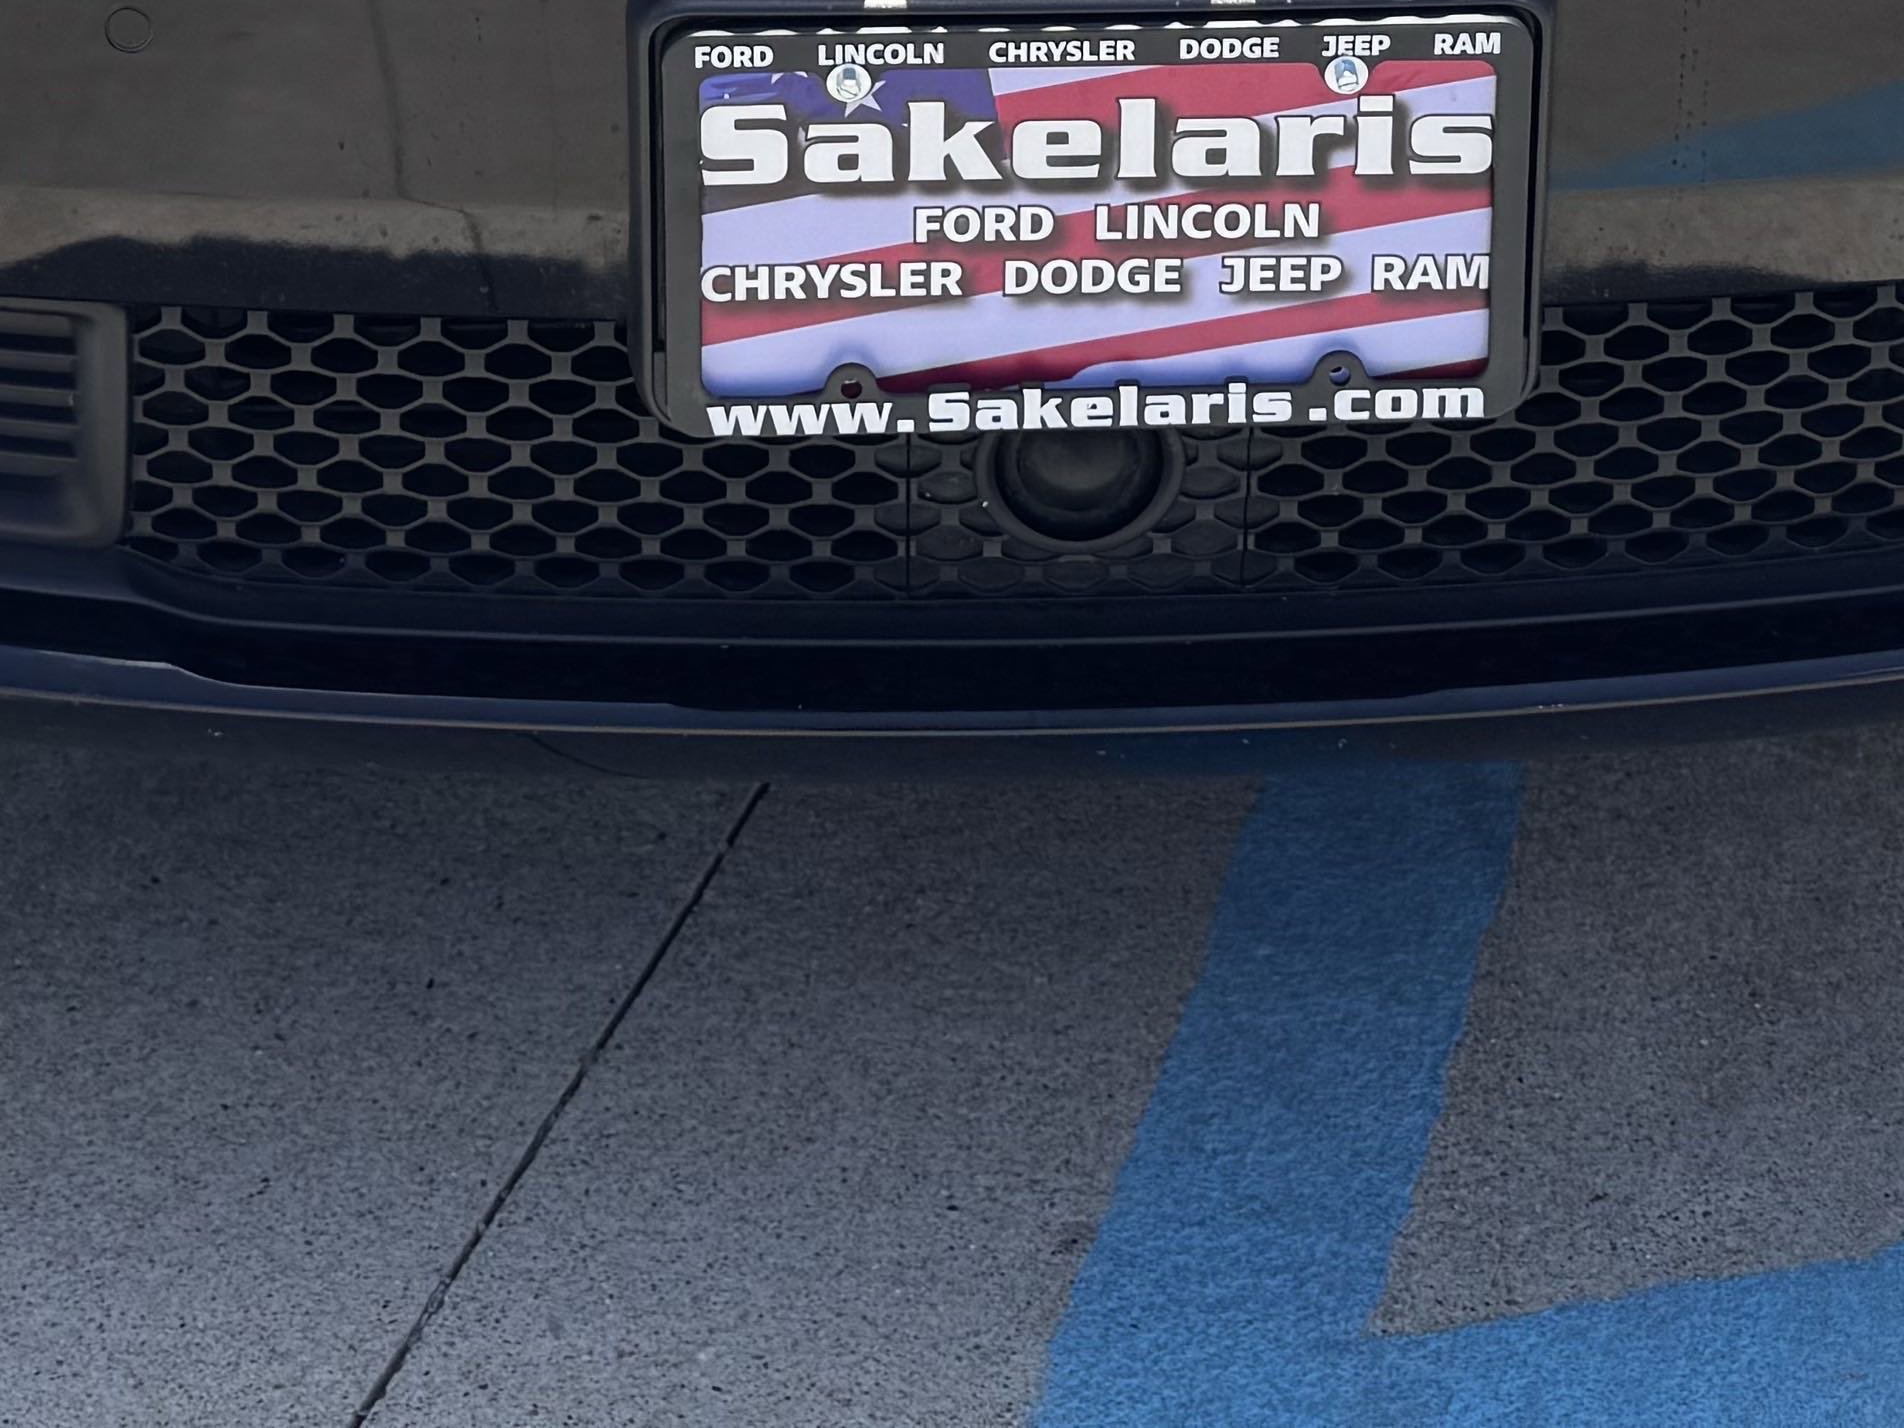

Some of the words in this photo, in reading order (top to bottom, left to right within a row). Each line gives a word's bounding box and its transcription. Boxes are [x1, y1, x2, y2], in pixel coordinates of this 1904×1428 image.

[695, 45, 774, 68] FORD
[817, 42, 945, 66] LINCOLN
[988, 37, 1136, 63] CHRYSLER
[1179, 36, 1280, 60] DODGE
[1321, 34, 1391, 58] JEEP
[1433, 32, 1501, 55] RAM
[699, 95, 1493, 187] Sakelaris
[914, 207, 1055, 243] FORD
[1095, 203, 1321, 240] LINCOLN
[700, 261, 964, 302] CHRYSLER
[1004, 258, 1183, 296] DODGE
[1220, 255, 1343, 293] JEEP
[1373, 254, 1489, 291] RAM
